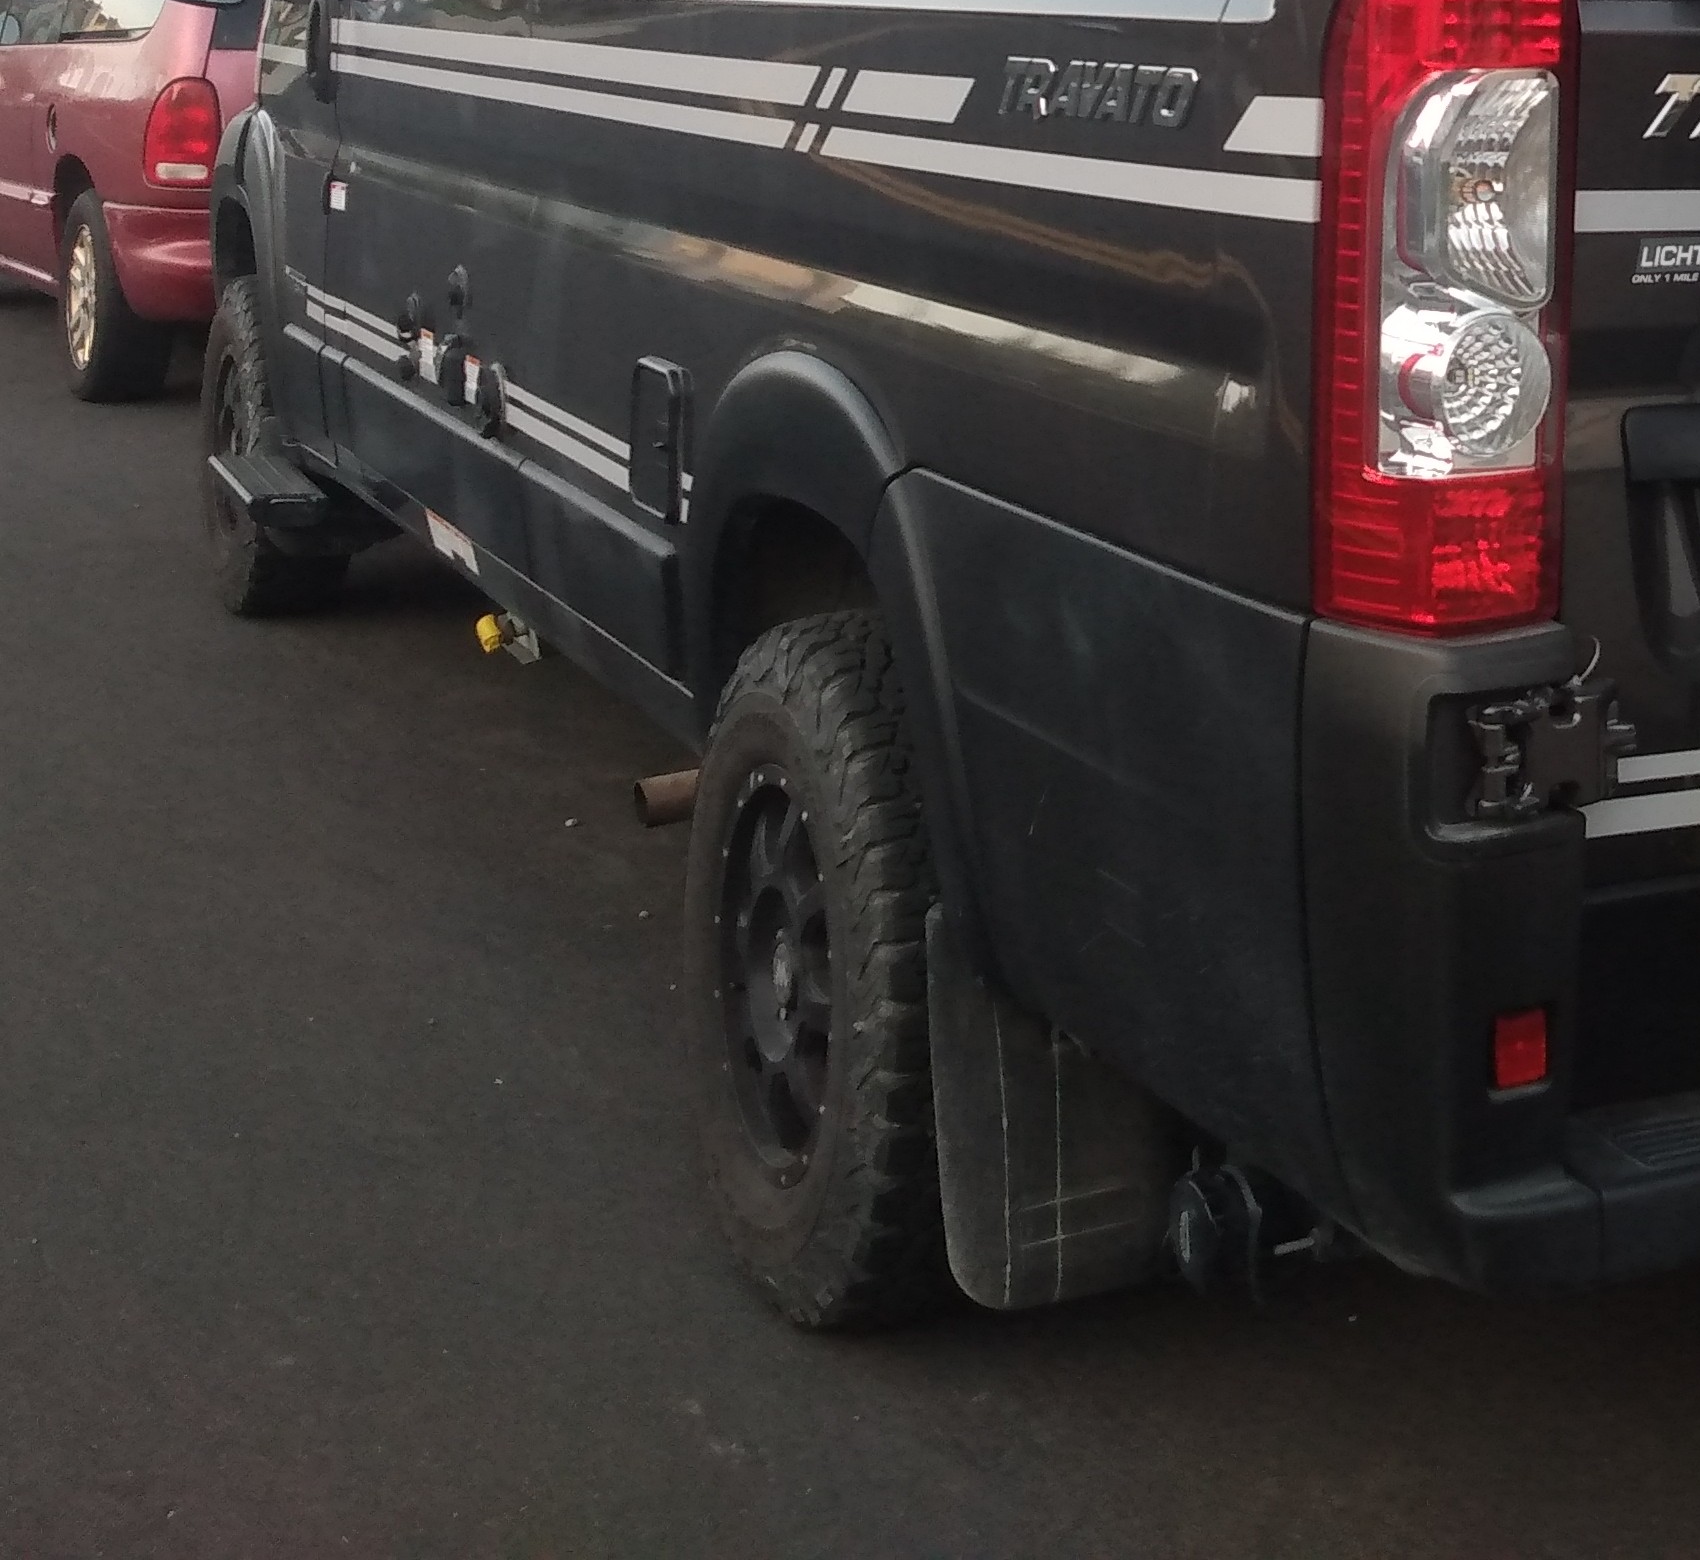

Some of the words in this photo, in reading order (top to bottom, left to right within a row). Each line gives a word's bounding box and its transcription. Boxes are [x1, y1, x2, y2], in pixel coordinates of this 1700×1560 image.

[998, 55, 1199, 128] TRAVATO
[1631, 273, 1661, 284] ONLY
[1664, 272, 1670, 283] 1
[1673, 272, 1699, 282] MILE
